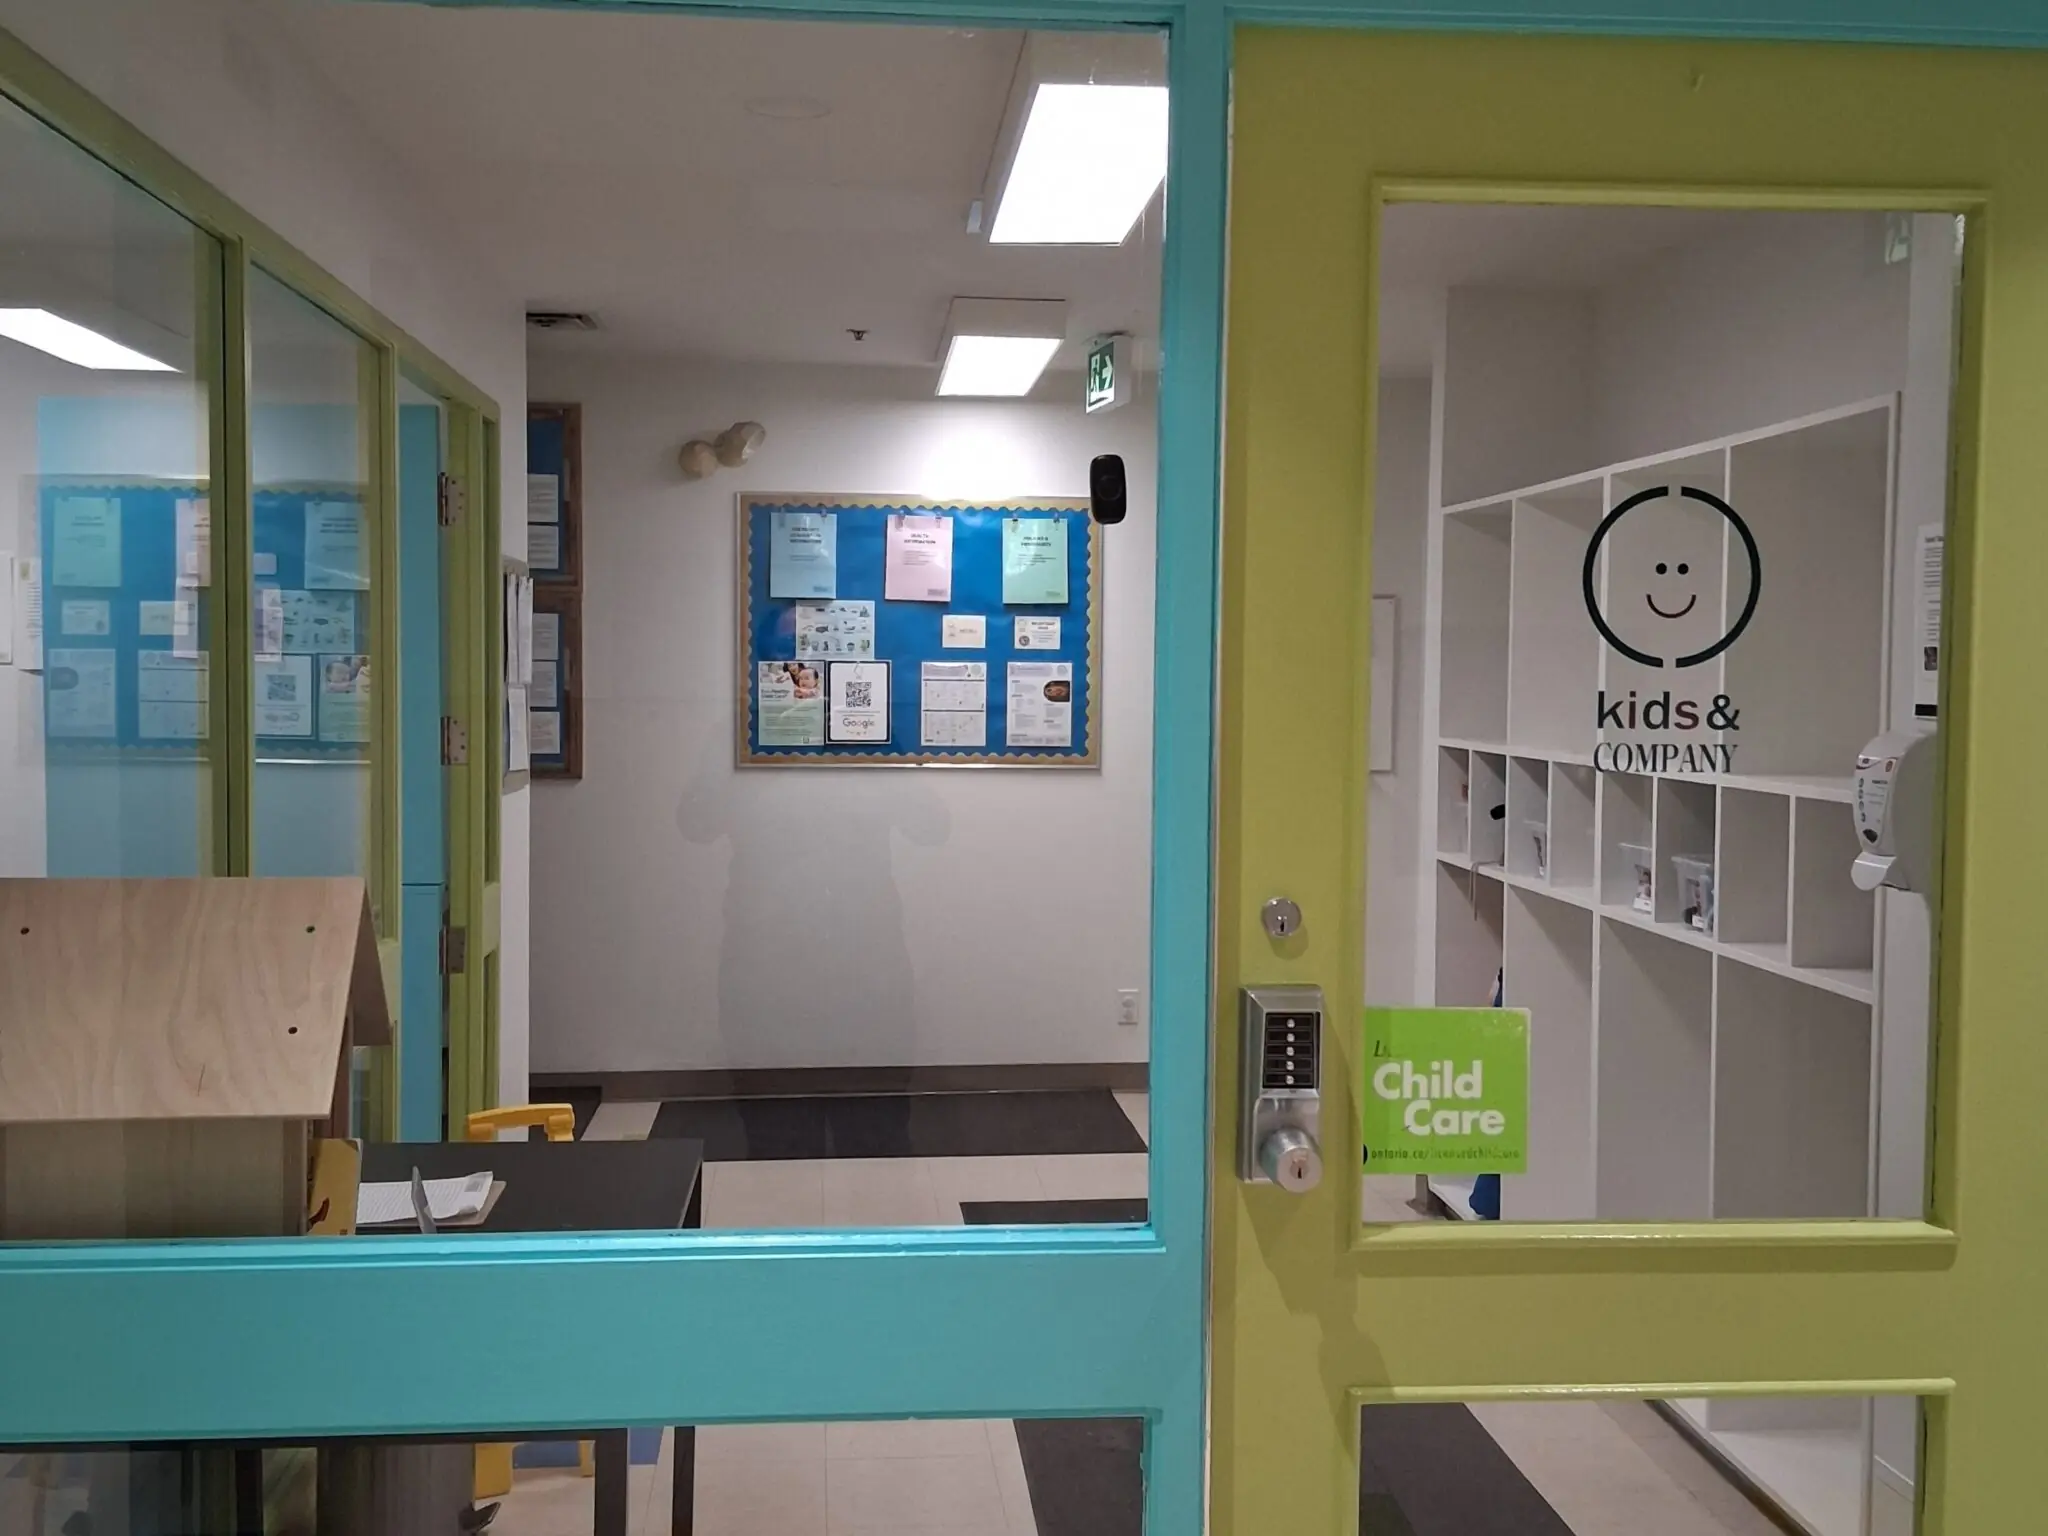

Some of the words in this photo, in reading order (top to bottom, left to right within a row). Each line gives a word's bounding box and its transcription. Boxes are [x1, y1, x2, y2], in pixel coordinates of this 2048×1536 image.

[842, 718, 875, 729] Google
[1593, 742, 1738, 773] COMPANY
[1373, 1060, 1483, 1100] Child
[1404, 1099, 1505, 1136] Care
